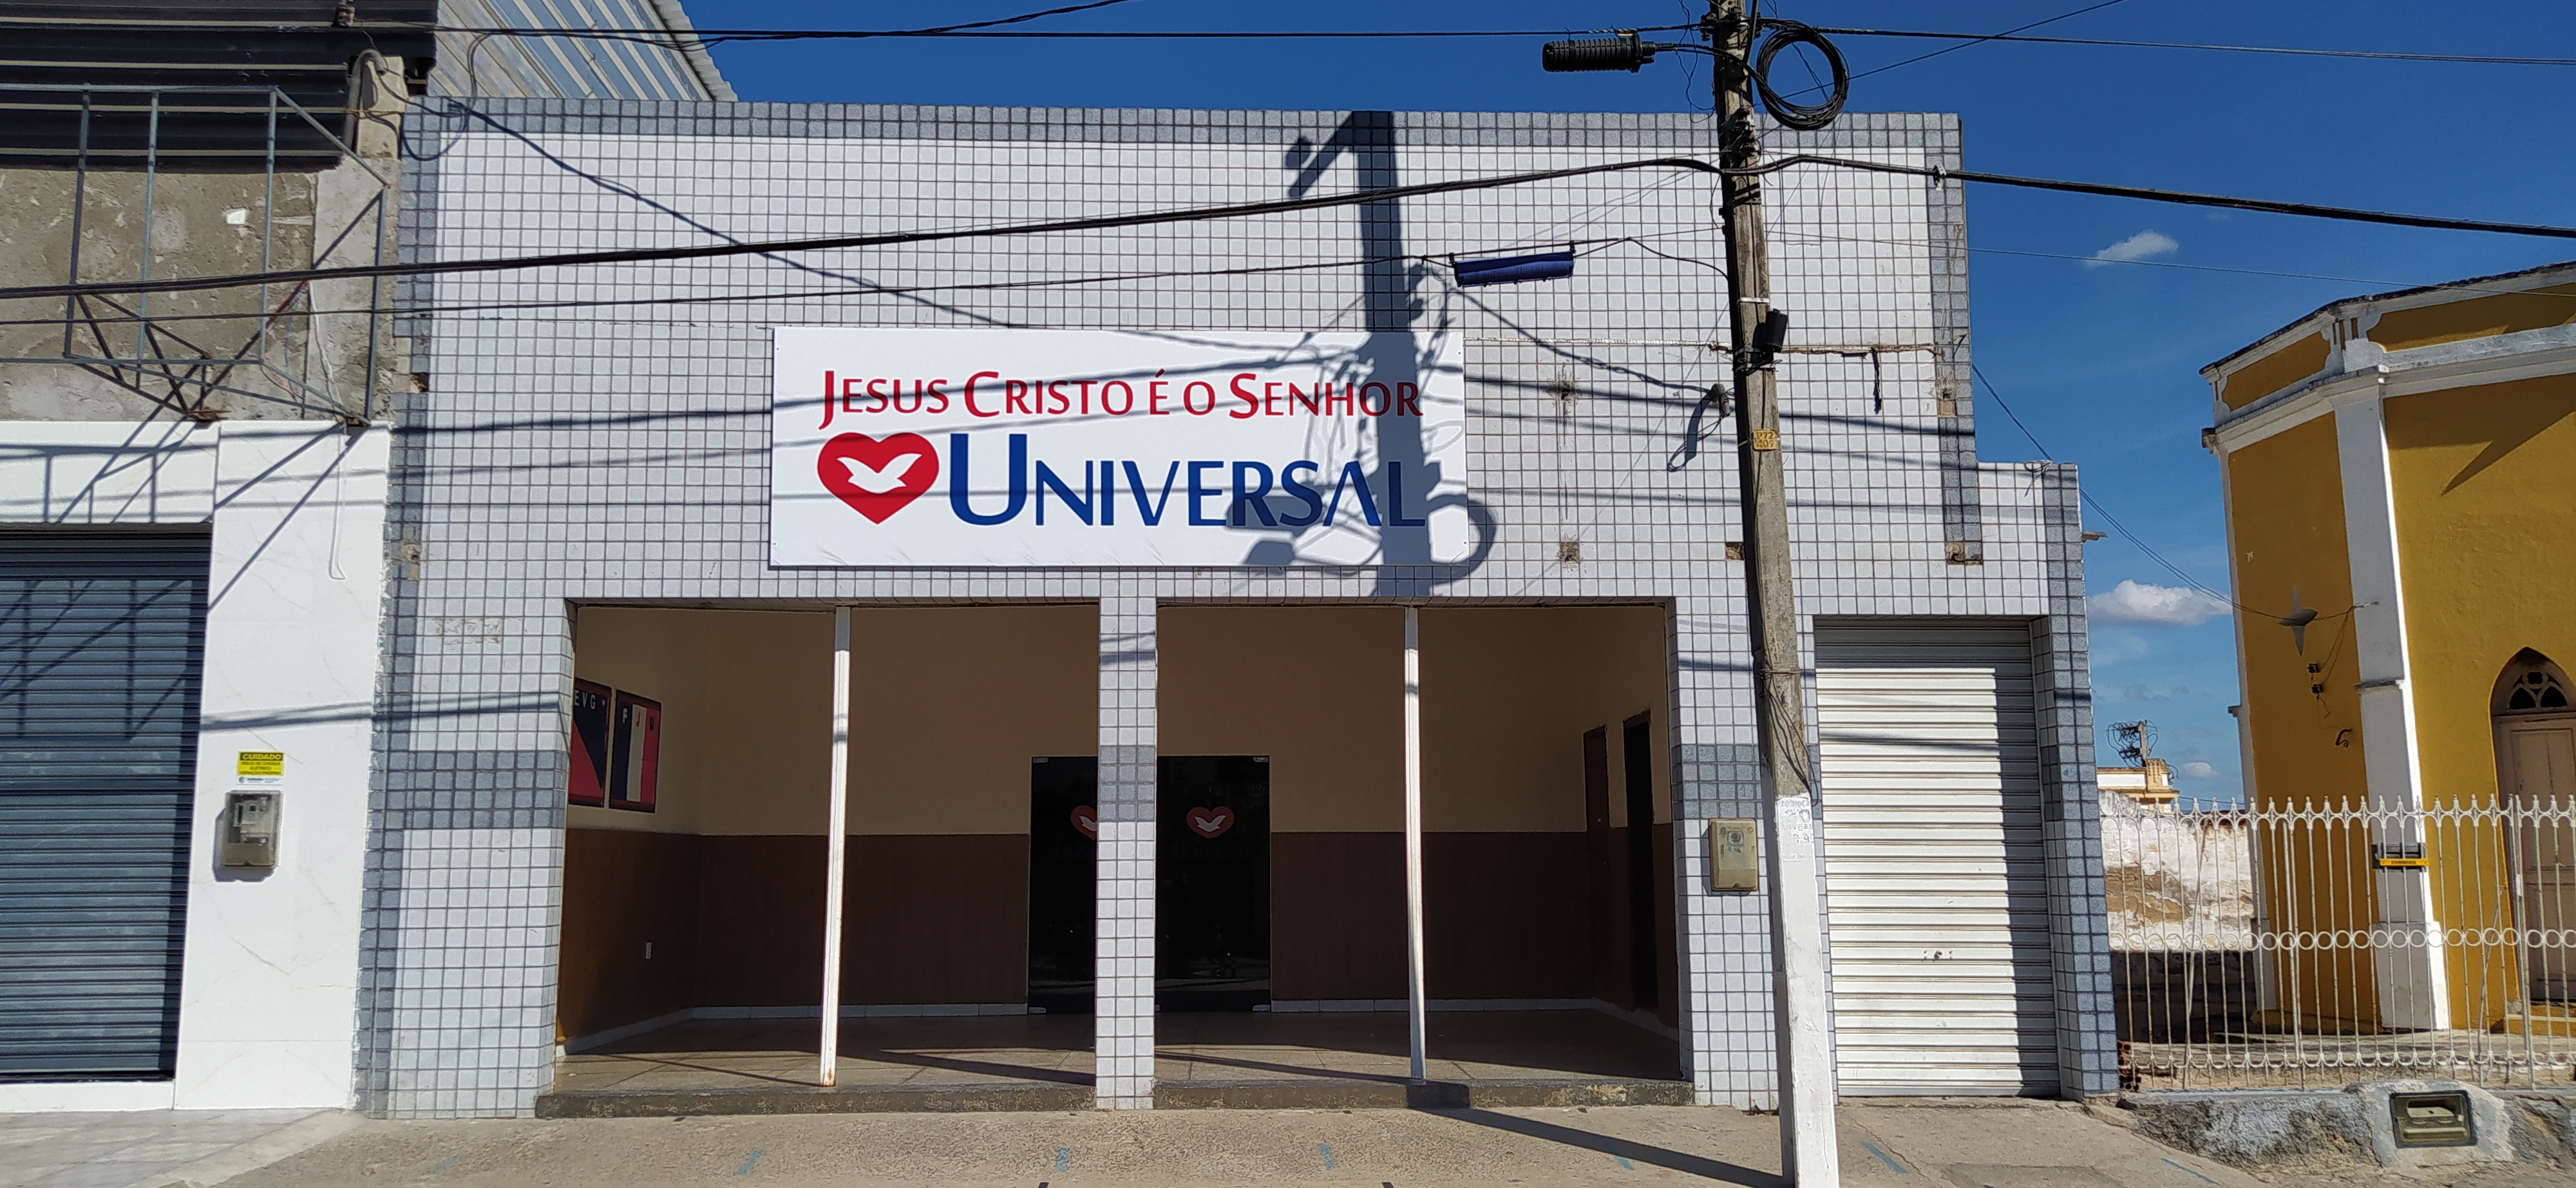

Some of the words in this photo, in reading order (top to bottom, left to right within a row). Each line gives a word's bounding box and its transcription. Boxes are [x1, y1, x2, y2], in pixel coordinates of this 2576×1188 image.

[818, 370, 949, 430] JESUS
[963, 370, 1134, 417] CRISTO
[1149, 369, 1171, 416] É
[1183, 380, 1216, 416] O
[1229, 372, 1424, 419] SENHOR
[949, 432, 1426, 527] UNIVERSAL
